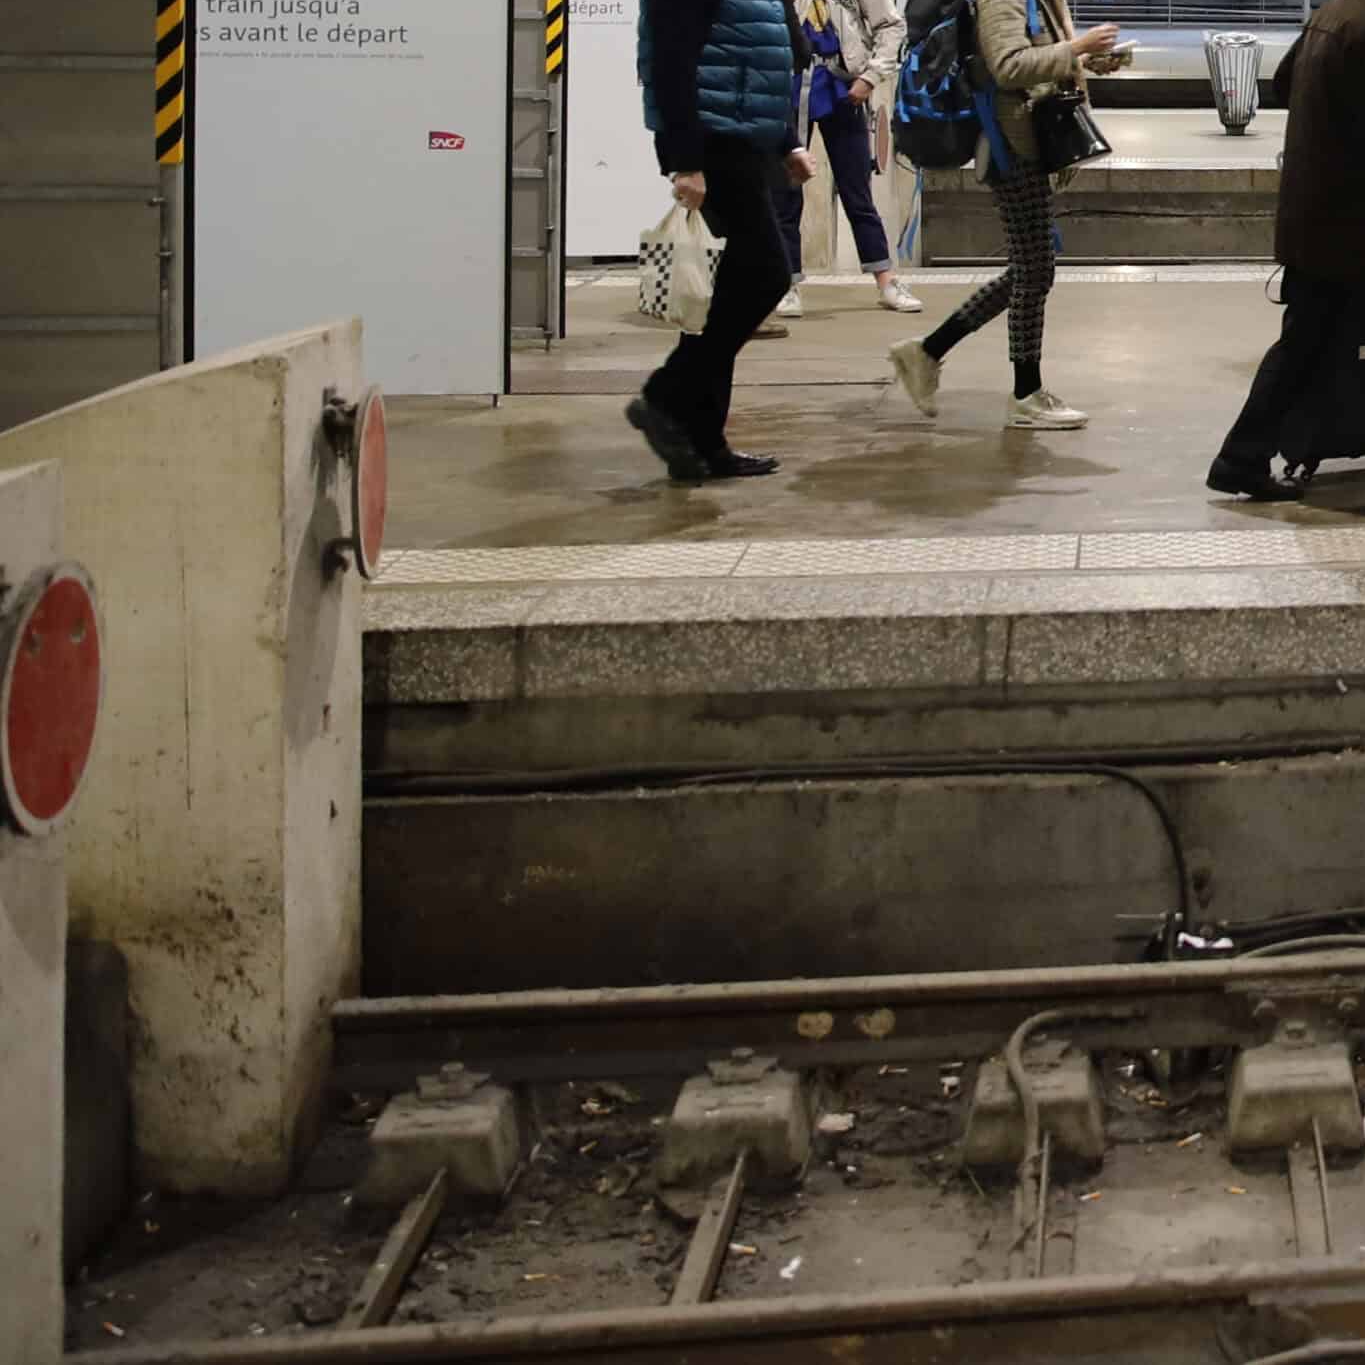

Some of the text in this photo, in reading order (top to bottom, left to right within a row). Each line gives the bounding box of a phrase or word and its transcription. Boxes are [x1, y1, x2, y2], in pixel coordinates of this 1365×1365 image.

[219, 25, 289, 43] avant
[298, 22, 319, 43] le
[327, 23, 409, 48] départ
[431, 137, 465, 149] SNCF
